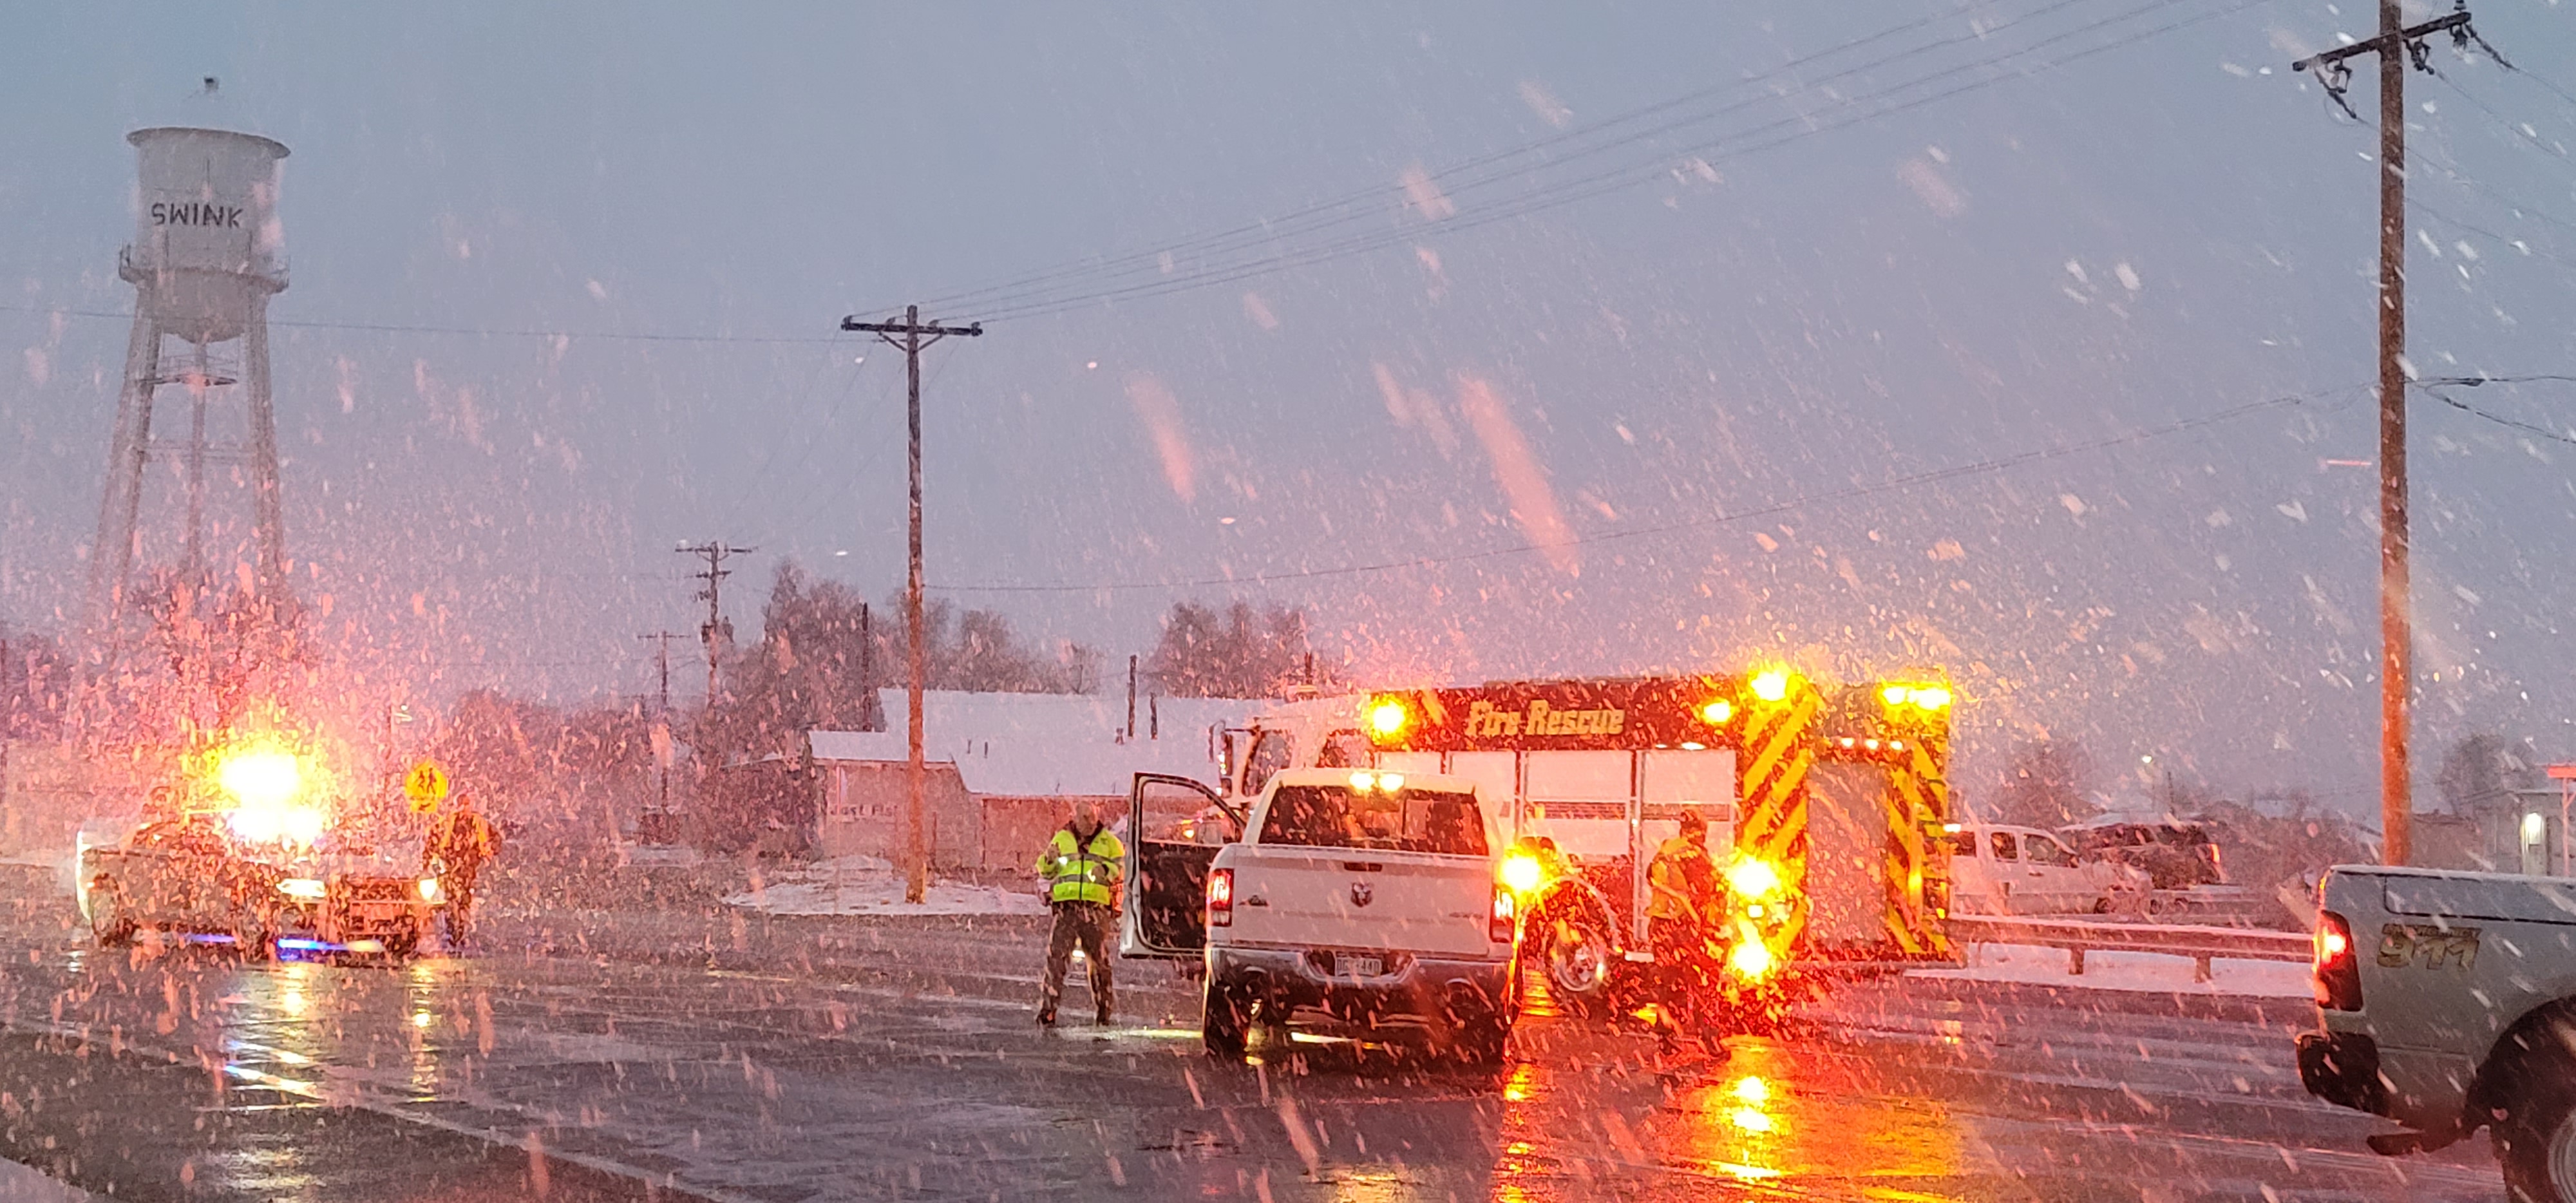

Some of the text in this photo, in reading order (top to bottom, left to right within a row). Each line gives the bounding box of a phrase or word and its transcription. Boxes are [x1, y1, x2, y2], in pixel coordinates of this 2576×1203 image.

[151, 202, 243, 227] SWINK
[1465, 699, 1625, 735] Fire Rescue
[2376, 935, 2479, 970] 911
